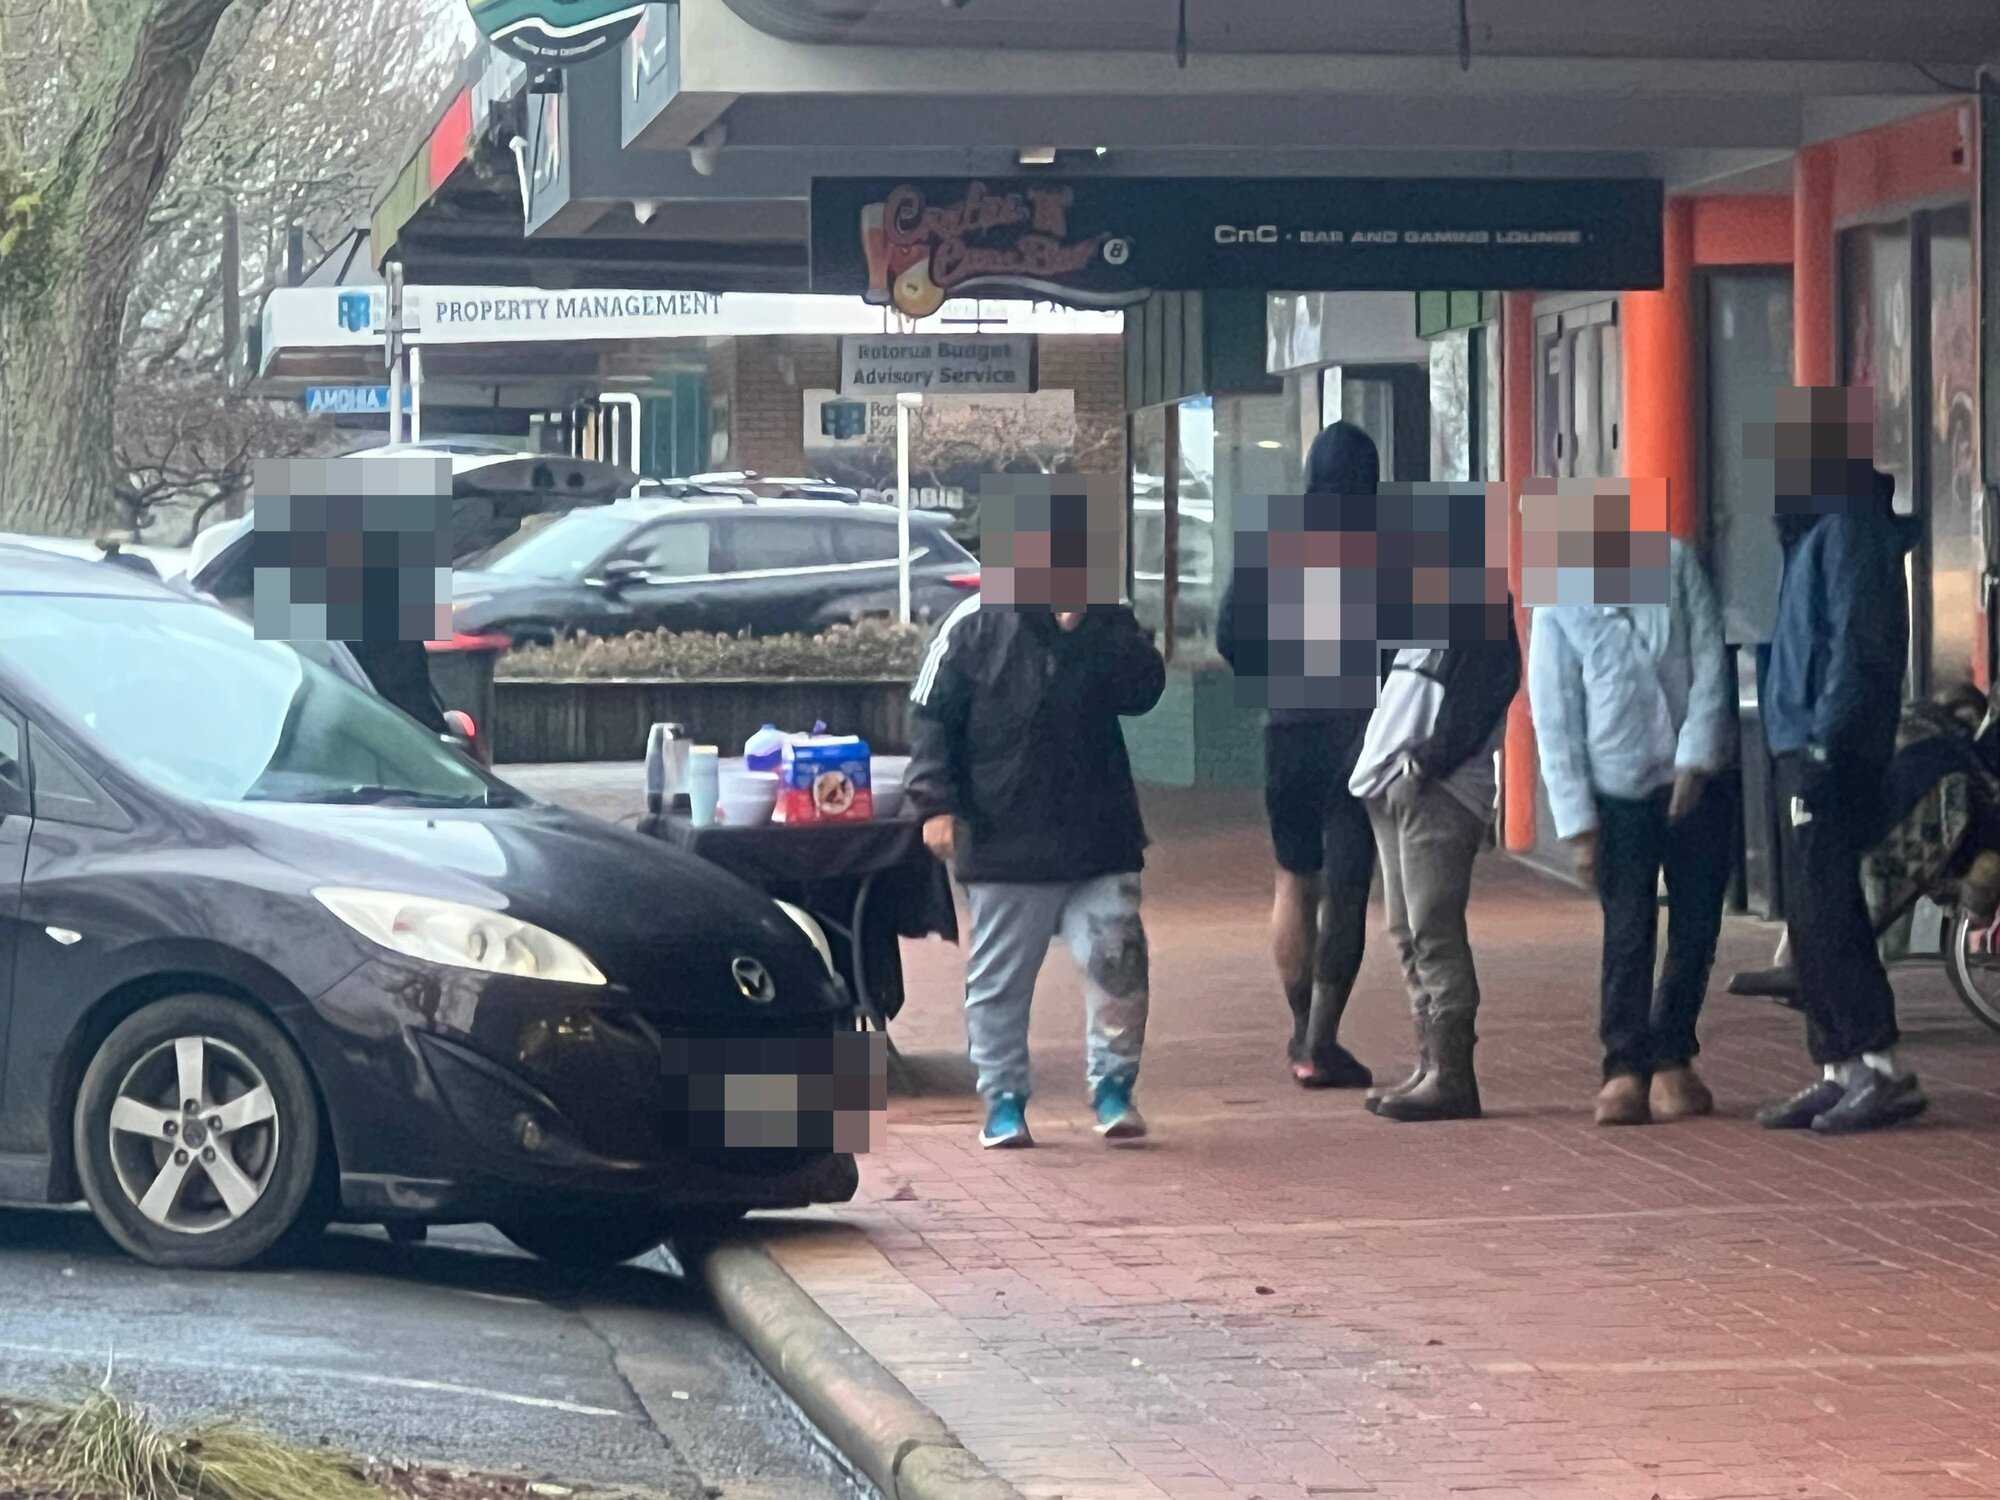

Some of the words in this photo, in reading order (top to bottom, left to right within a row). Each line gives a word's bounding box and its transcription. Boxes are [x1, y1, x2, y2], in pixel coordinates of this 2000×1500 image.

[1214, 225, 1278, 243] CnC
[435, 298, 550, 323] PROPERTY
[556, 293, 723, 319] MANAGEMENT
[858, 343, 931, 360] Rotorua
[938, 342, 1011, 362] Budget
[853, 366, 934, 387] Advisory
[939, 367, 1015, 384] Service
